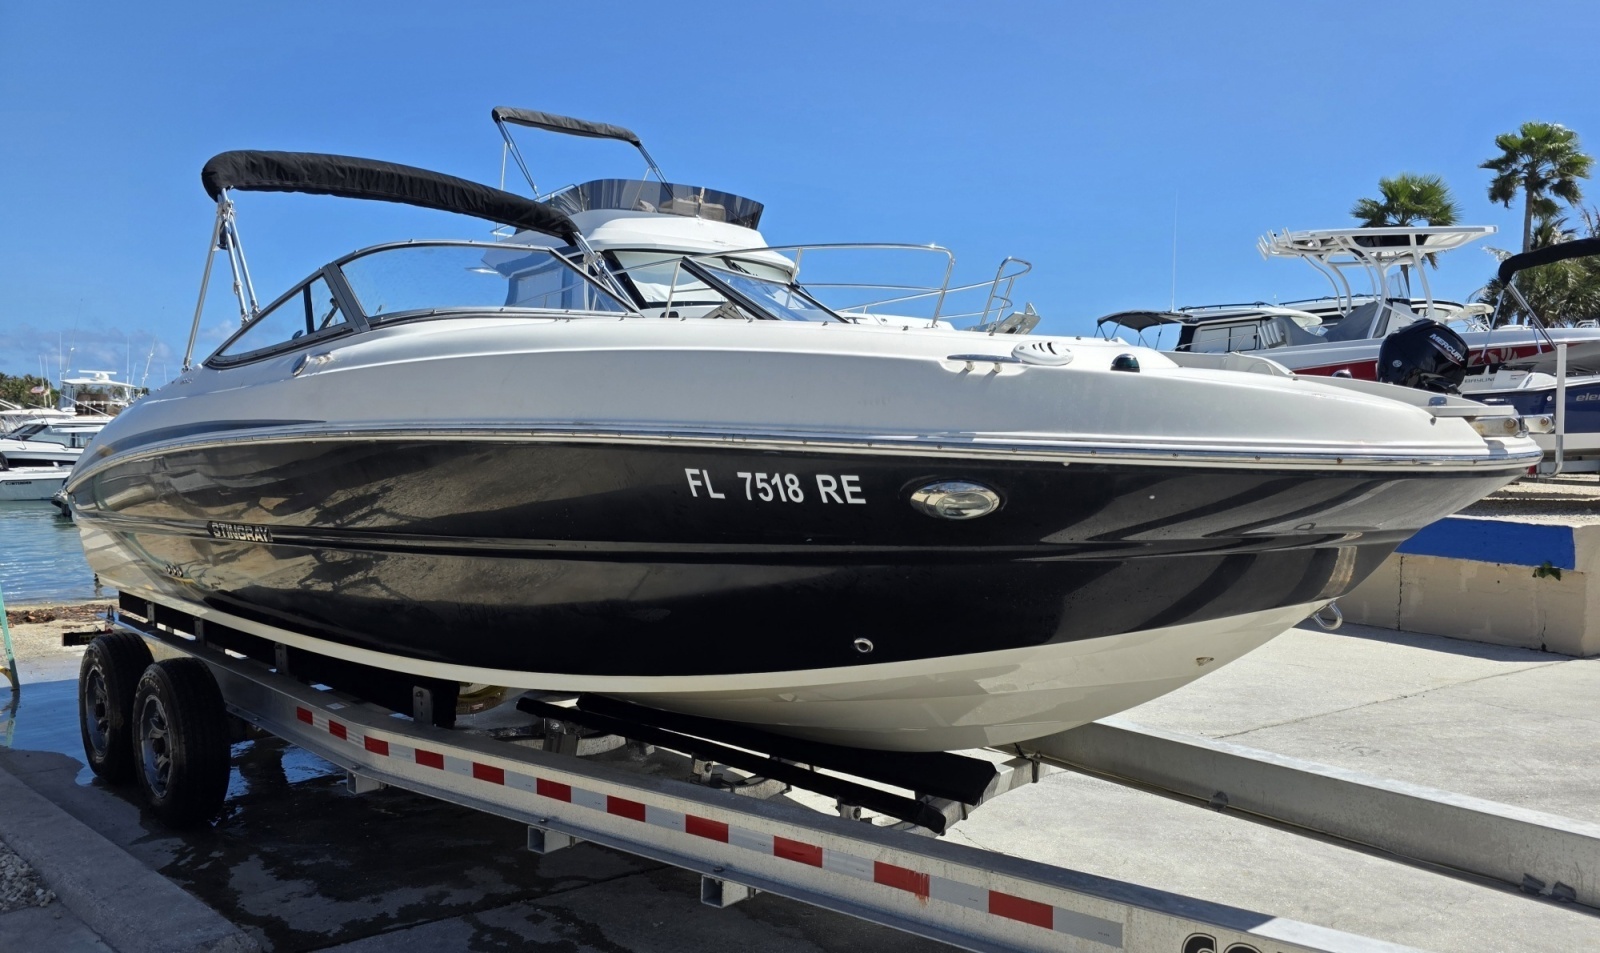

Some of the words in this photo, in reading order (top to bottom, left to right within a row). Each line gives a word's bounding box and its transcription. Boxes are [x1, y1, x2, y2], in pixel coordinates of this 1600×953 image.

[1429, 333, 1465, 362] MERCURY
[1575, 392, 1600, 401] ele
[684, 468, 726, 499] FL
[736, 472, 804, 503] 7518
[815, 474, 867, 504] RE
[211, 522, 269, 543] STINGRAY
